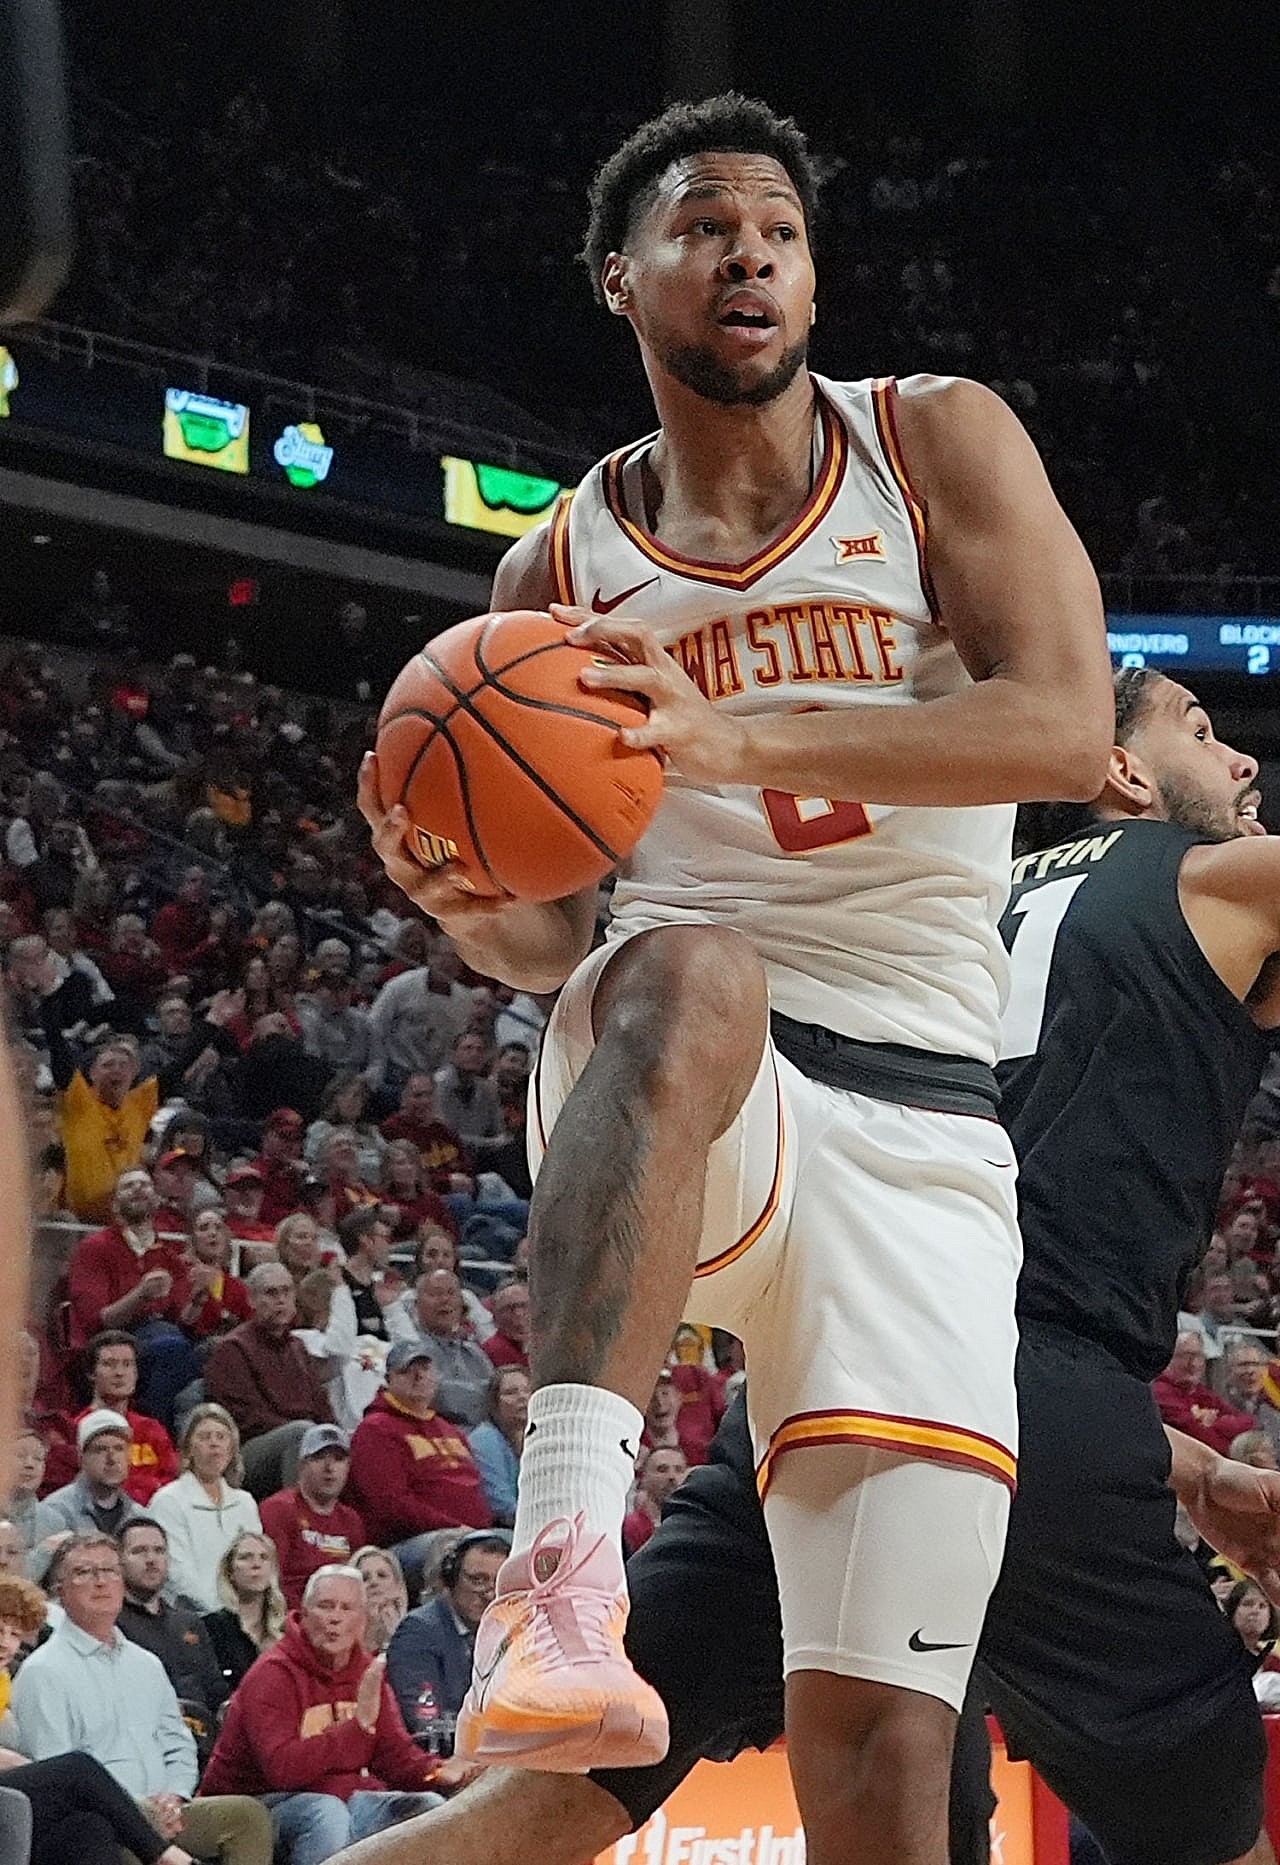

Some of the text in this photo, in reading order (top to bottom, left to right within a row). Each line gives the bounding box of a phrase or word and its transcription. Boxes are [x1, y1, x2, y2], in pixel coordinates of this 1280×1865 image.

[663, 600, 904, 703] WA STATE
[1106, 632, 1189, 655] RNOVERS
[1247, 644, 1270, 675] 2
[1012, 829, 1125, 885] FFIN
